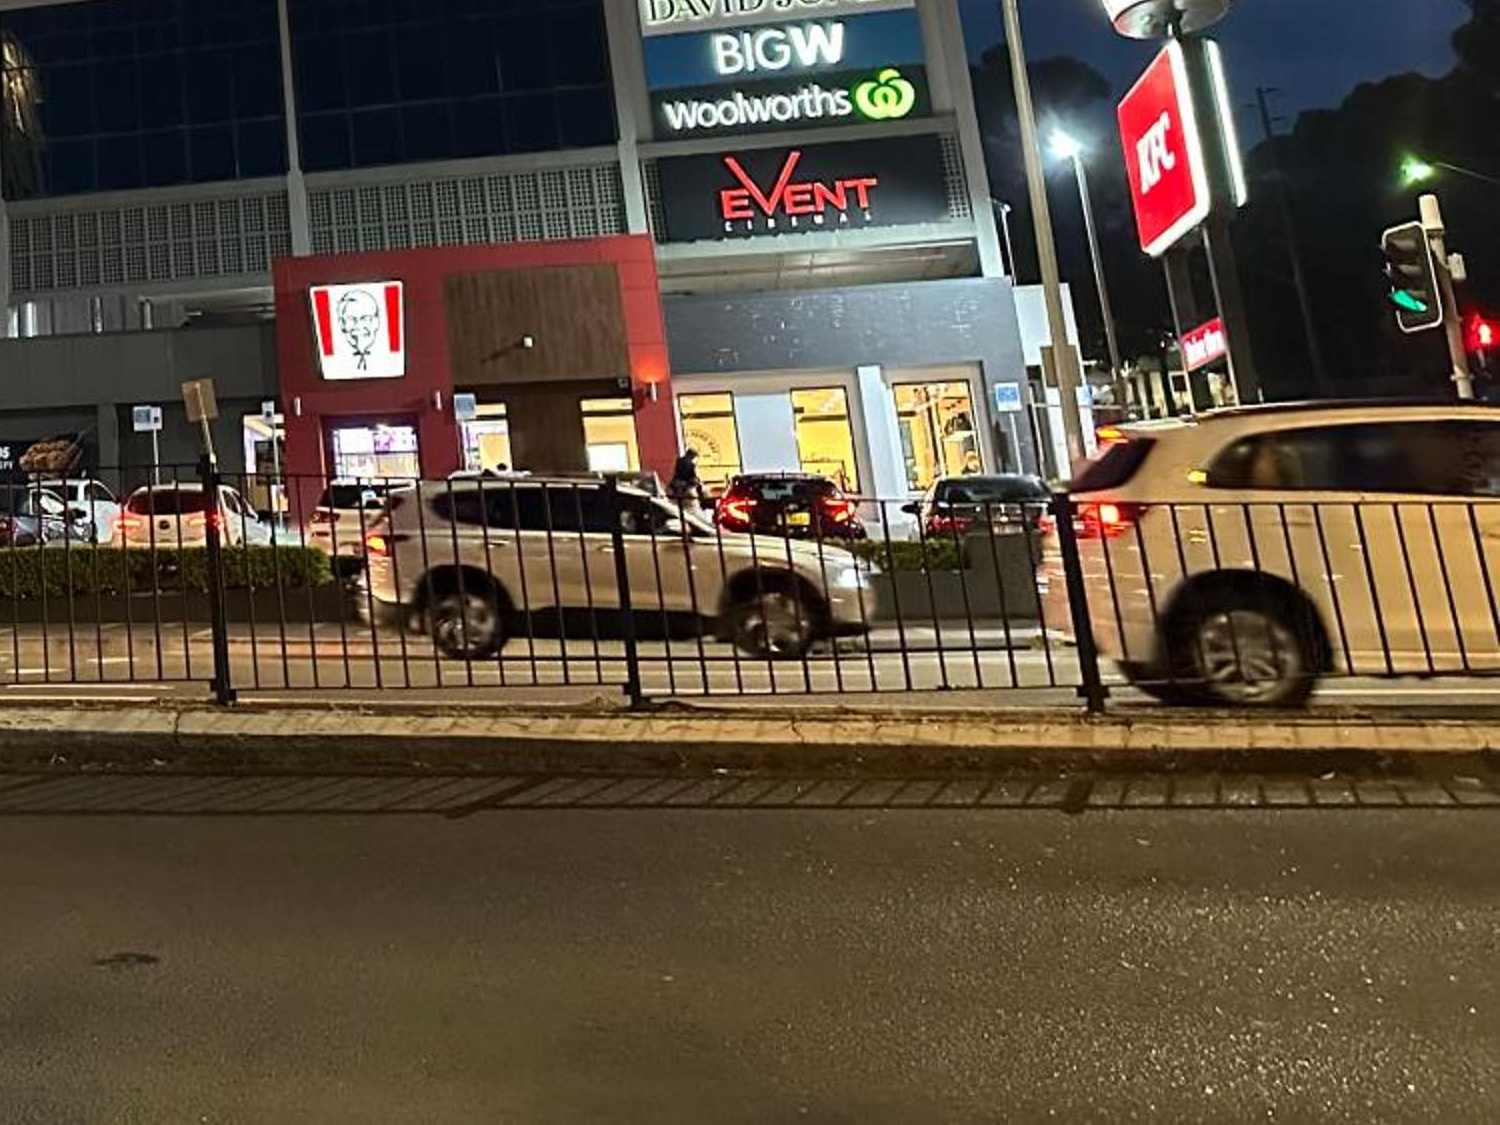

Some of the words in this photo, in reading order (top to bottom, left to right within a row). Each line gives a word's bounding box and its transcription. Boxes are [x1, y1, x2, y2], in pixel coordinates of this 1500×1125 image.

[662, 84, 853, 131] Woolworths
[720, 150, 878, 219] EVENT
[1135, 111, 1175, 196] KFC
